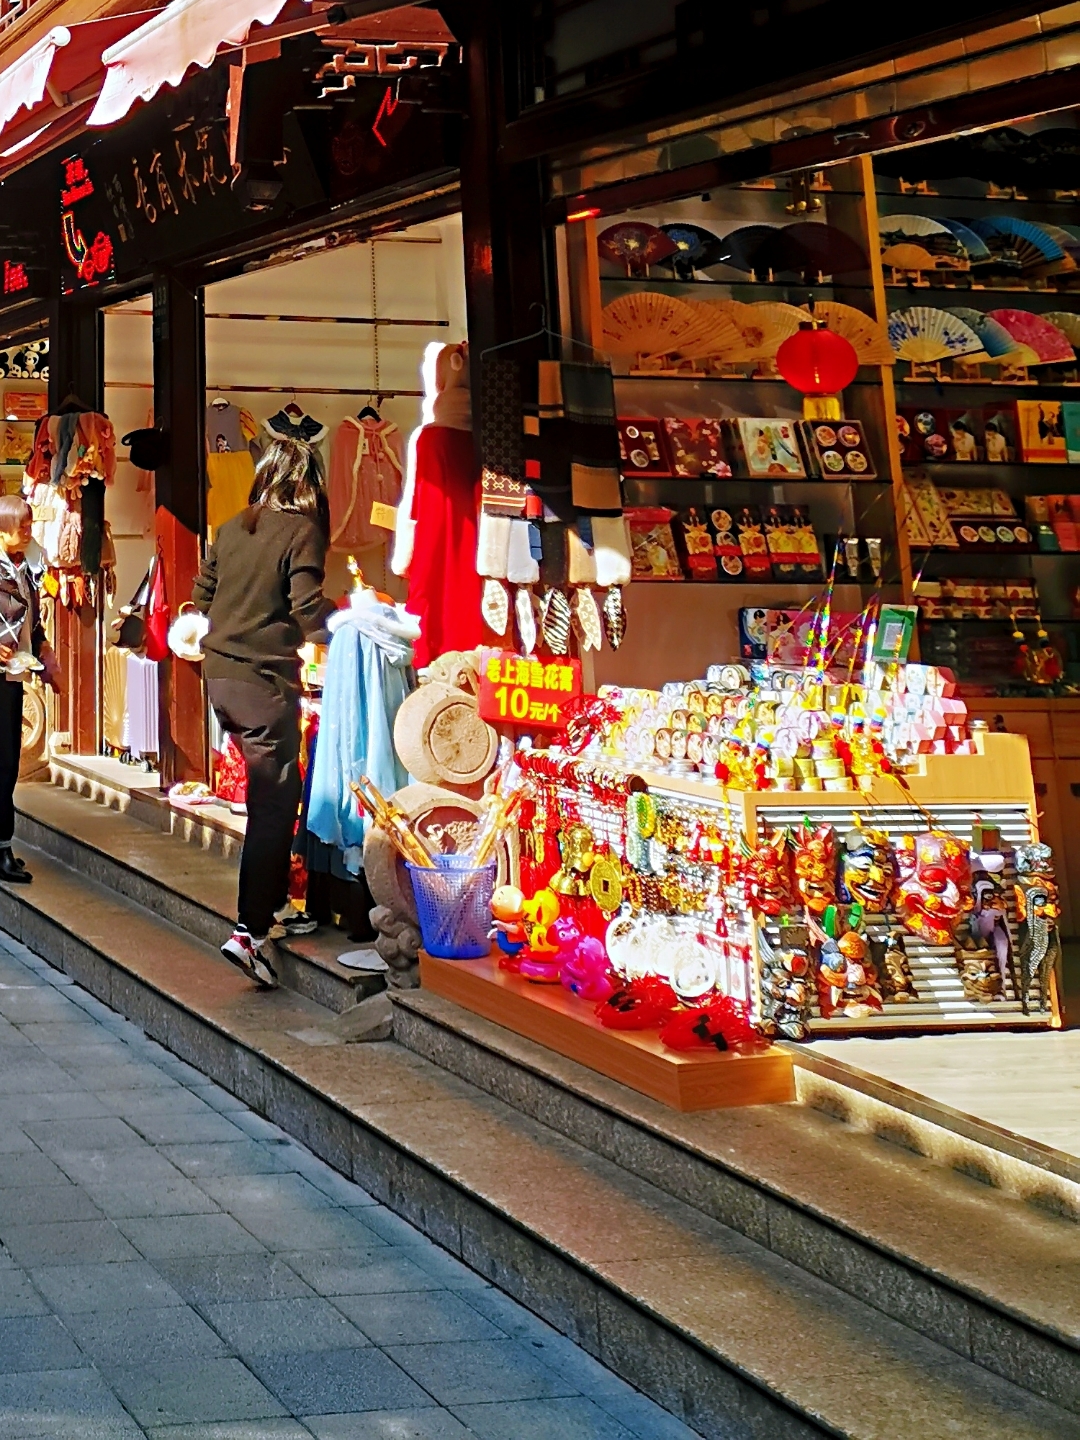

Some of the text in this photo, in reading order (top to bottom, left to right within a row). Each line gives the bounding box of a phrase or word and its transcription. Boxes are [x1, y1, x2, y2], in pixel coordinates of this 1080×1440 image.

[486, 657, 574, 692] 老上海雪花膏
